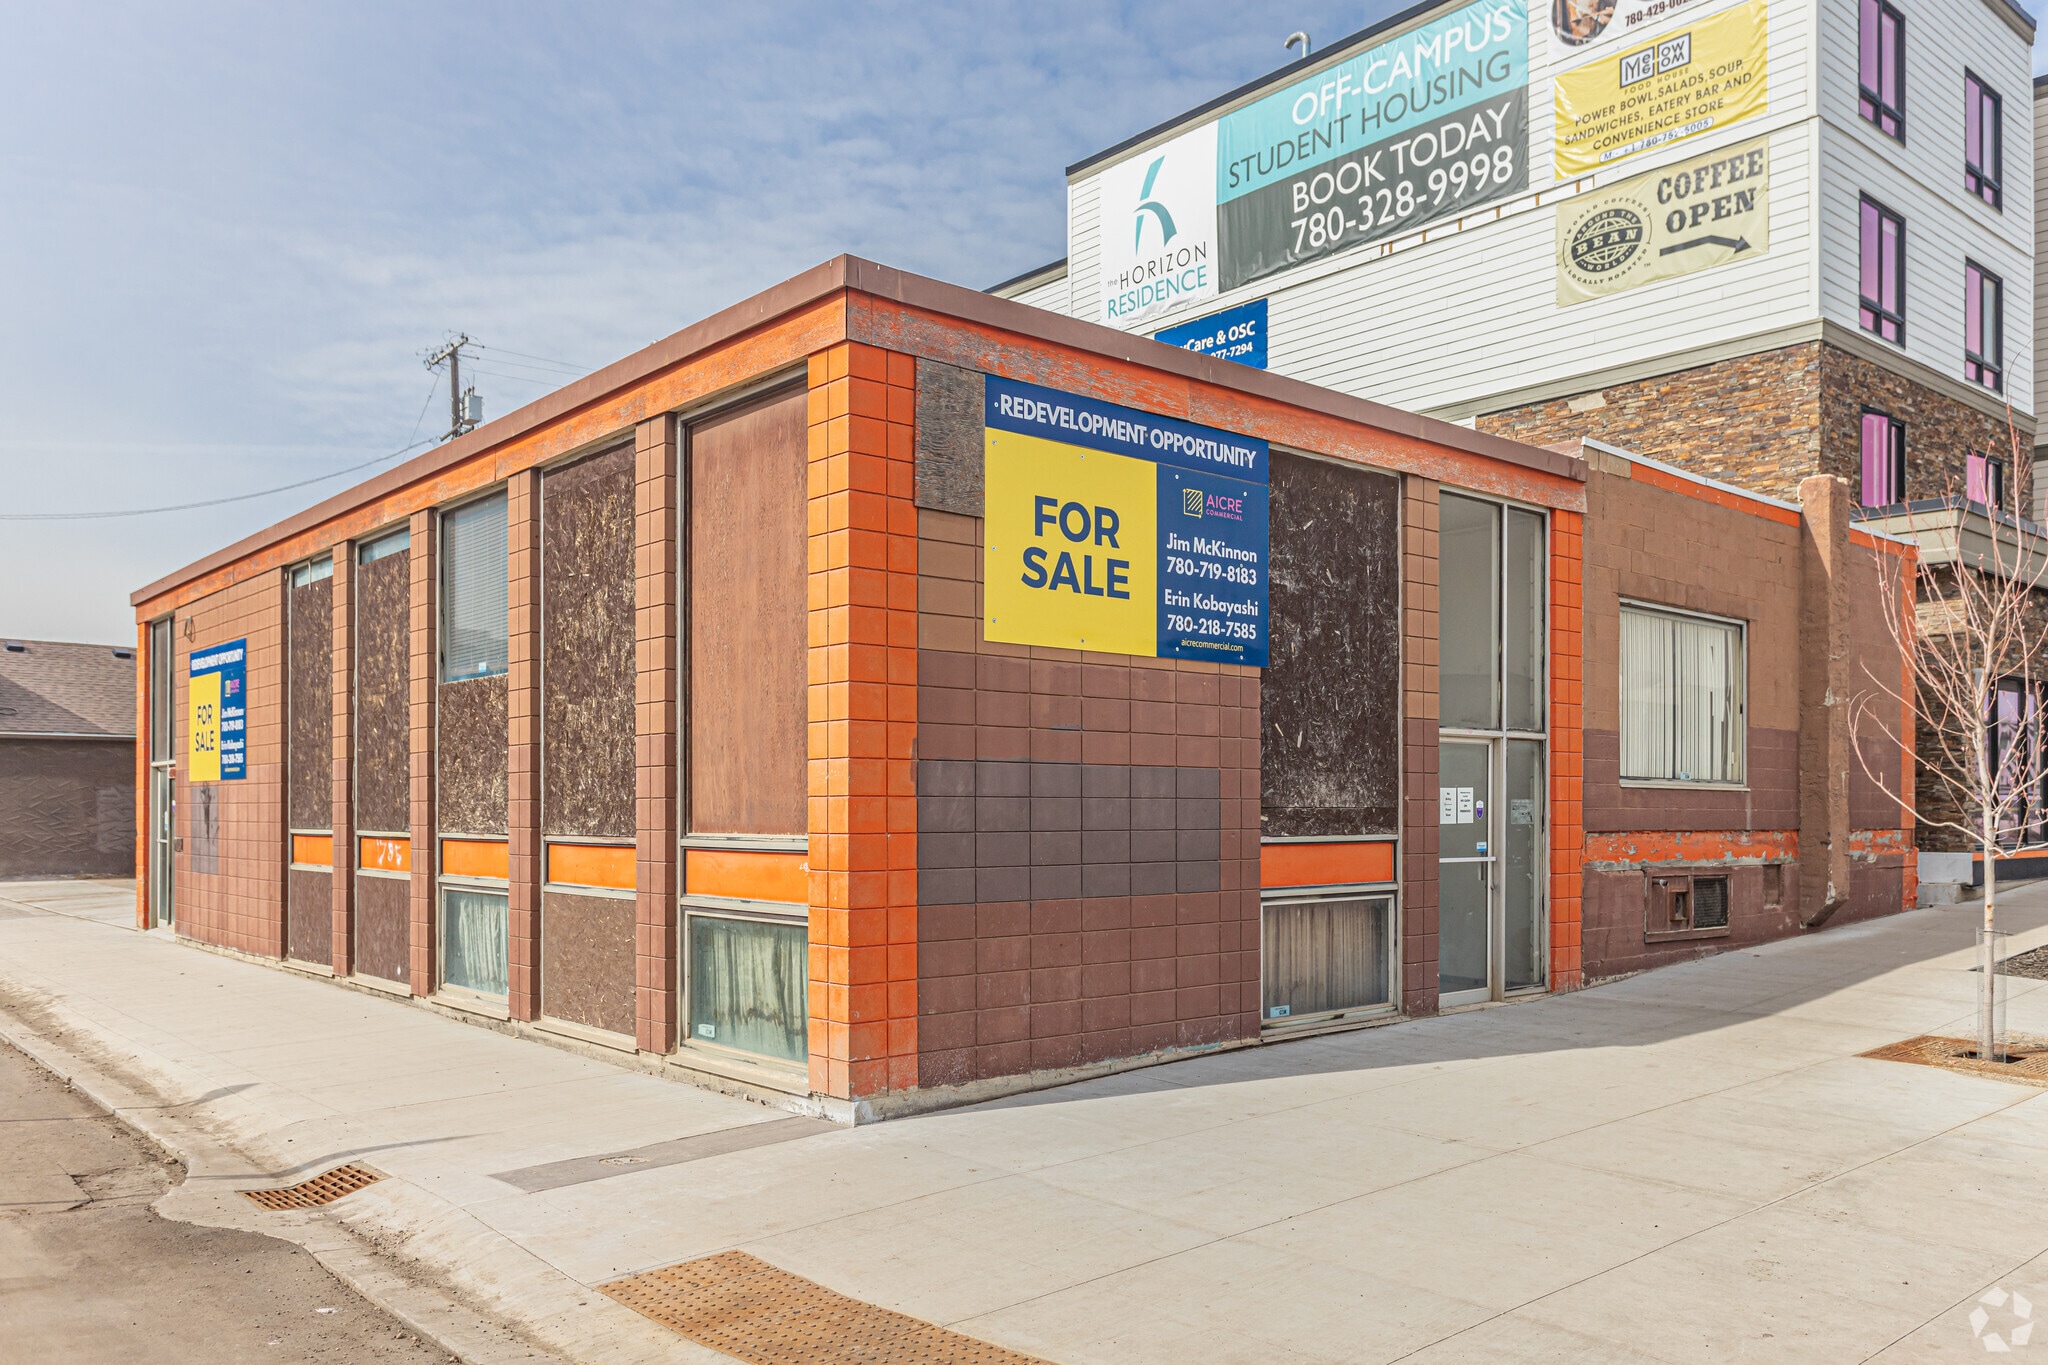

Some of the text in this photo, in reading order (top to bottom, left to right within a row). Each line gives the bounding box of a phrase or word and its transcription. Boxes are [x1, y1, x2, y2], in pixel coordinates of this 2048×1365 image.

[1292, 5, 1512, 125] OFF-CAMPUS
[1624, 67, 1689, 95] FOOD HOUSE
[1229, 50, 1511, 189] STUDENT HOUSING
[1564, 72, 1752, 145] SANDWICHES, EATERY BAR AND
[1575, 106, 1616, 127] POWER
[1593, 98, 1724, 150] CONVENIENCE STORE
[1292, 102, 1511, 214] BOOK TODAY
[1657, 148, 1763, 204] COFFEE
[1291, 145, 1513, 254] 780-328-9998
[1567, 197, 1648, 234] WORLD COFFEES
[1666, 187, 1756, 233] OPEN
[1575, 228, 1638, 255] BEAN
[1577, 210, 1638, 239] AROUND THE
[1107, 241, 1207, 290] the HORIZON
[1568, 248, 1647, 285] LOCALLY ROASTED
[1107, 264, 1208, 319] RESIDENCE
[1216, 329, 1226, 345] &
[1228, 320, 1256, 341] OSC
[1000, 393, 1257, 469] REDEVELOPMENT OPPORTUNITY
[1034, 495, 1120, 549] FOR
[1205, 508, 1243, 522] COMMERCIAL
[1206, 494, 1243, 513] AICRE
[1166, 532, 1258, 563] Jim McKinnon
[1021, 546, 1130, 600] SALE
[1166, 556, 1257, 586] 780-719-8183
[1164, 588, 1259, 618] Erin Kobayashi
[1167, 614, 1257, 640] 780-218-7585
[1181, 637, 1244, 652] aicrecommercial.com
[197, 703, 213, 726] FOR
[195, 730, 215, 752] SALE
